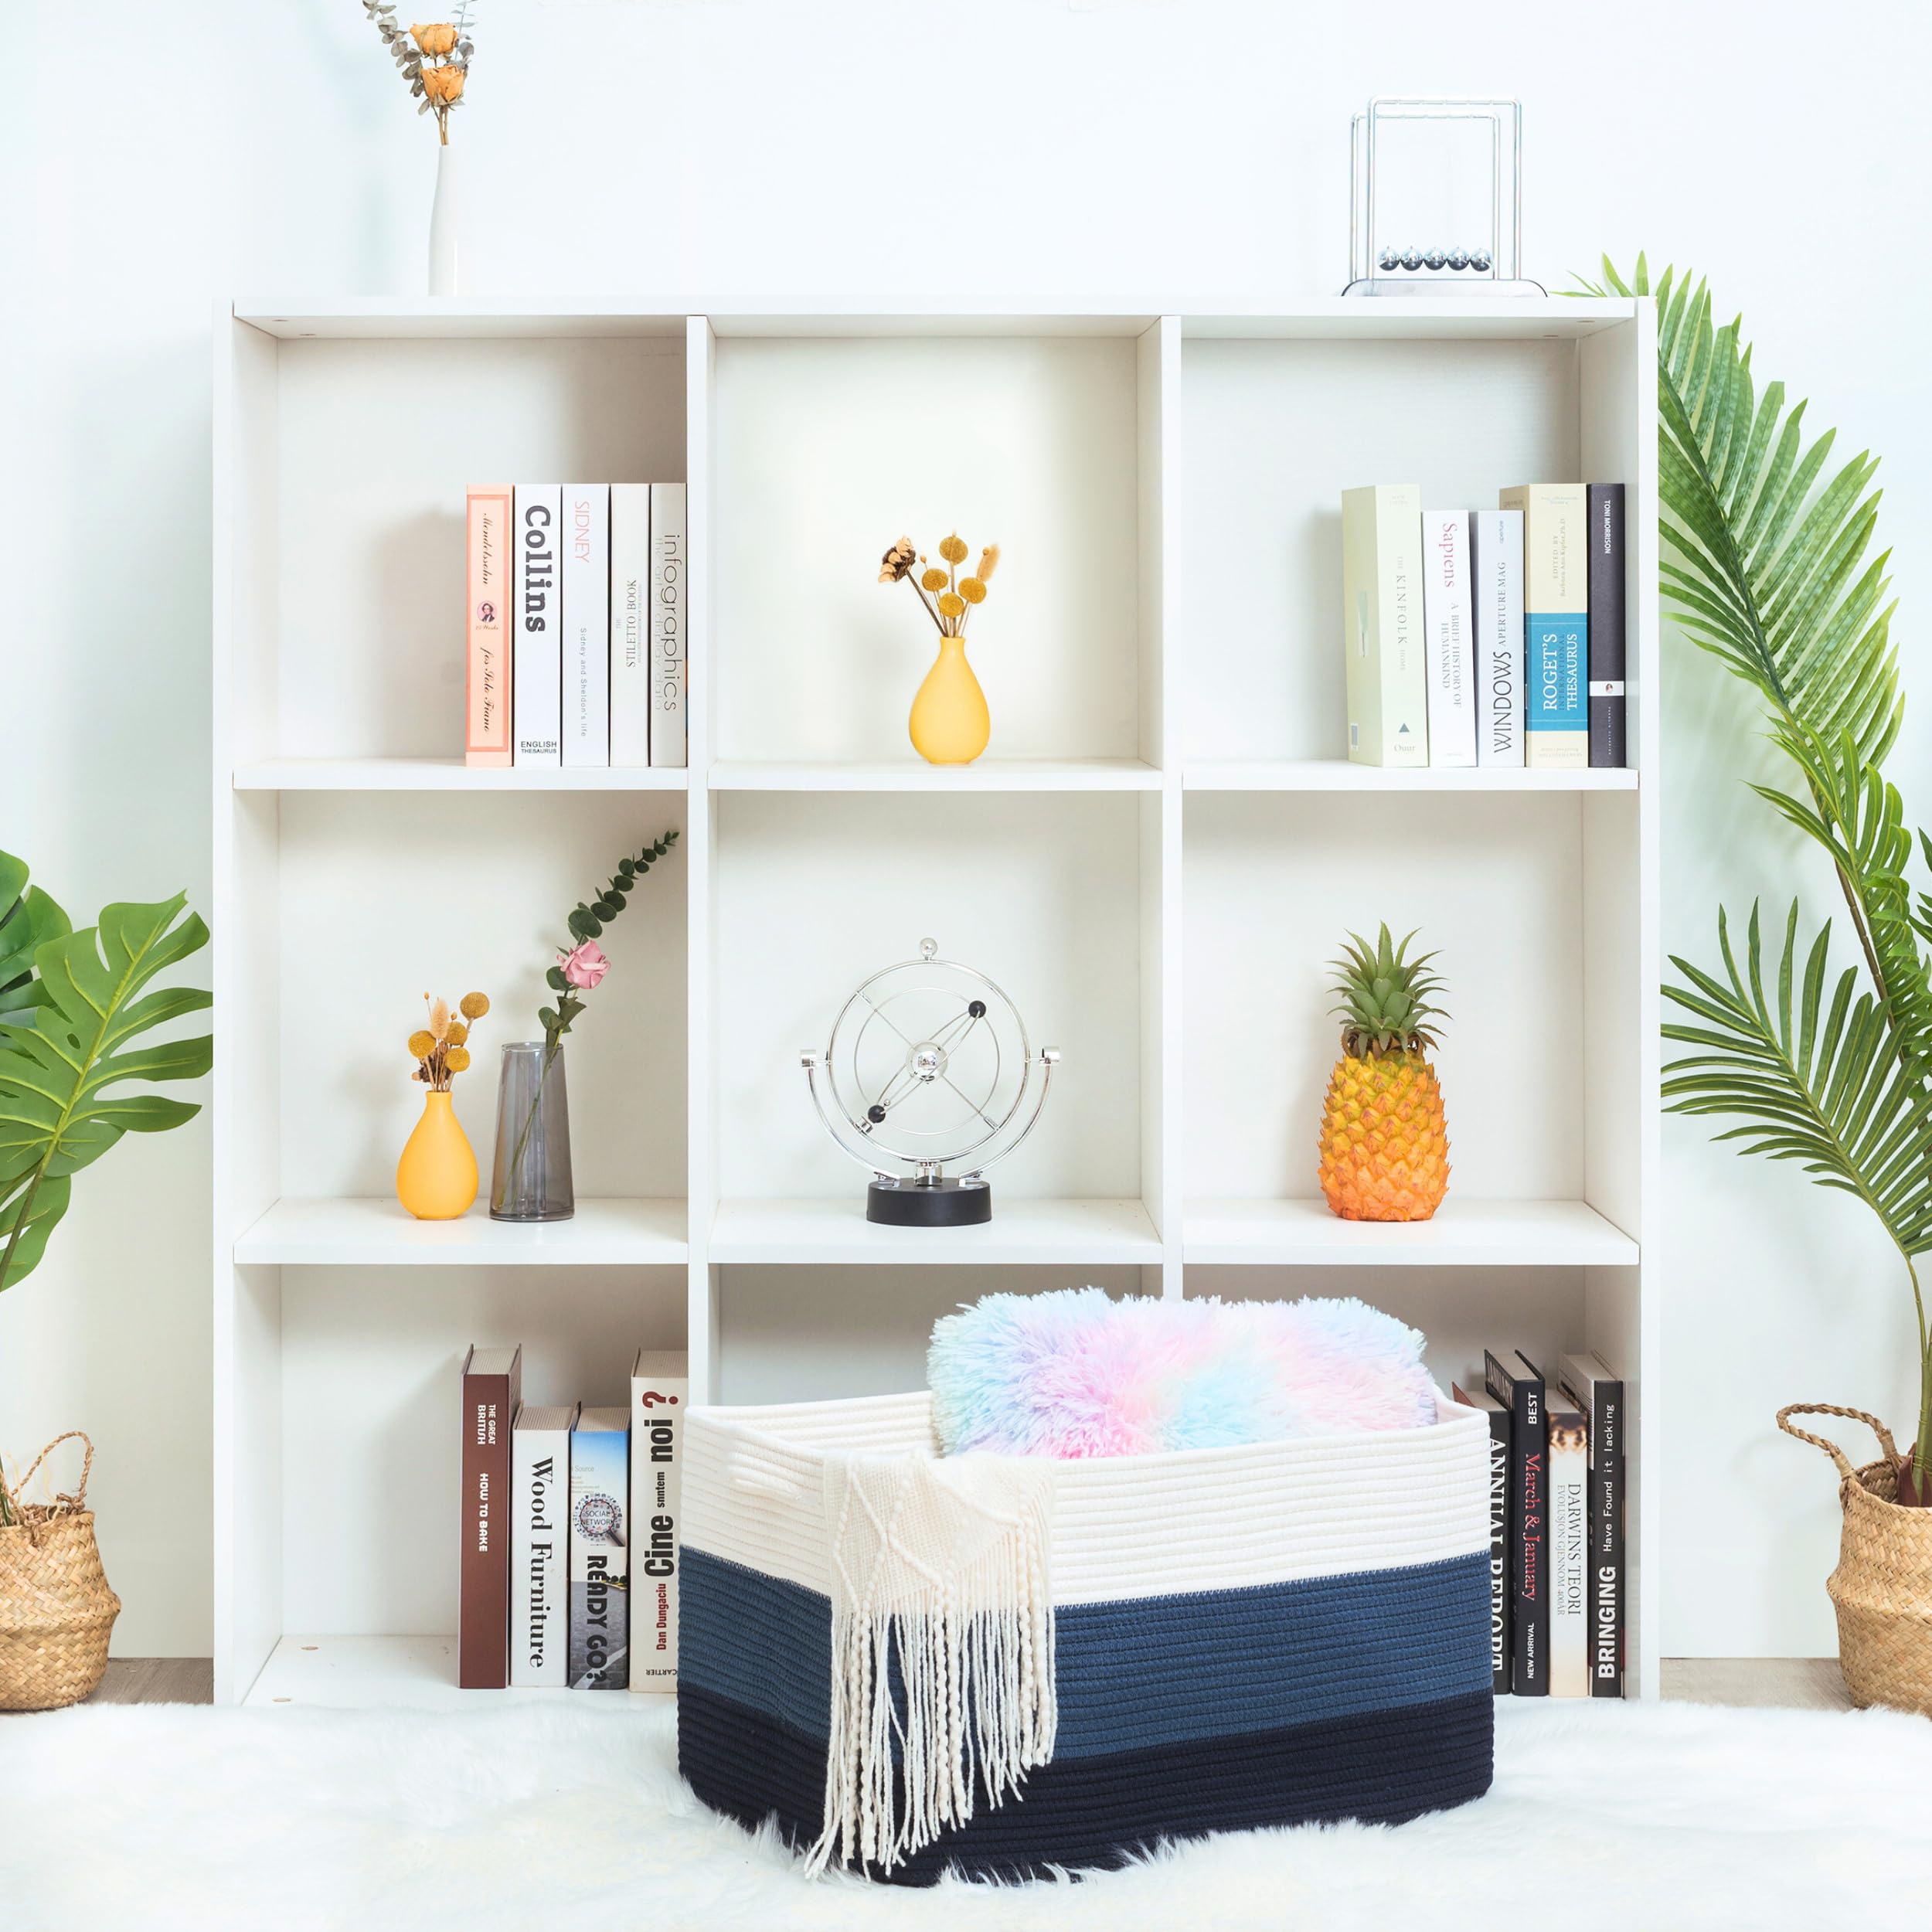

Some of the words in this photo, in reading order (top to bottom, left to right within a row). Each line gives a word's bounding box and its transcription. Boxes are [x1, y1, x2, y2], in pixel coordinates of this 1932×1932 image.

[575, 501, 590, 563] SIDNEY
[1439, 523, 1458, 587] Sapiens
[1553, 535, 1559, 545] BY
[526, 505, 552, 632] Collins
[1497, 562, 1506, 587] MAG
[627, 580, 637, 610] BOOK
[1396, 575, 1407, 644] KINFOLK
[1498, 590, 1506, 647] APERTURE
[626, 616, 636, 668] STILETTO
[661, 535, 682, 711] infographics
[1451, 614, 1460, 645] BRIEF
[1440, 622, 1451, 689] HUMANKIND
[1452, 646, 1461, 691] HISTORY
[1543, 634, 1557, 710] ROGET'S
[1566, 634, 1577, 710] THESAURUS
[1453, 692, 1462, 709] OF
[1493, 651, 1512, 753] WINDOWS
[641, 1391, 679, 1409] ?
[1528, 1392, 1538, 1424] BEST
[478, 1404, 486, 1445] BRITISH
[644, 1419, 673, 1463] noi
[1604, 1404, 1614, 1452] lacking
[480, 1472, 488, 1500] HOW
[655, 1471, 665, 1509] snntem
[1526, 1454, 1540, 1509] March
[1604, 1461, 1613, 1473] it
[479, 1503, 488, 1518] TO
[531, 1456, 553, 1531] Wood
[1556, 1485, 1566, 1539] EVOLUSJON
[1603, 1481, 1613, 1517] Found
[478, 1520, 488, 1552] BAKE
[1525, 1514, 1539, 1529] &
[1568, 1484, 1580, 1561] DARWINS
[1604, 1523, 1613, 1552] Have
[645, 1515, 675, 1577] Cine
[1522, 1532, 1540, 1601] January
[1556, 1541, 1566, 1587] GJENNOM
[529, 1543, 553, 1668] Furniture
[587, 1555, 608, 1630] READY
[655, 1583, 668, 1628] Dungaciu
[1568, 1565, 1580, 1615] TEORI
[656, 1632, 666, 1651] Dan
[1599, 1566, 1616, 1679] BRINGING
[587, 1635, 608, 1681] GO?
